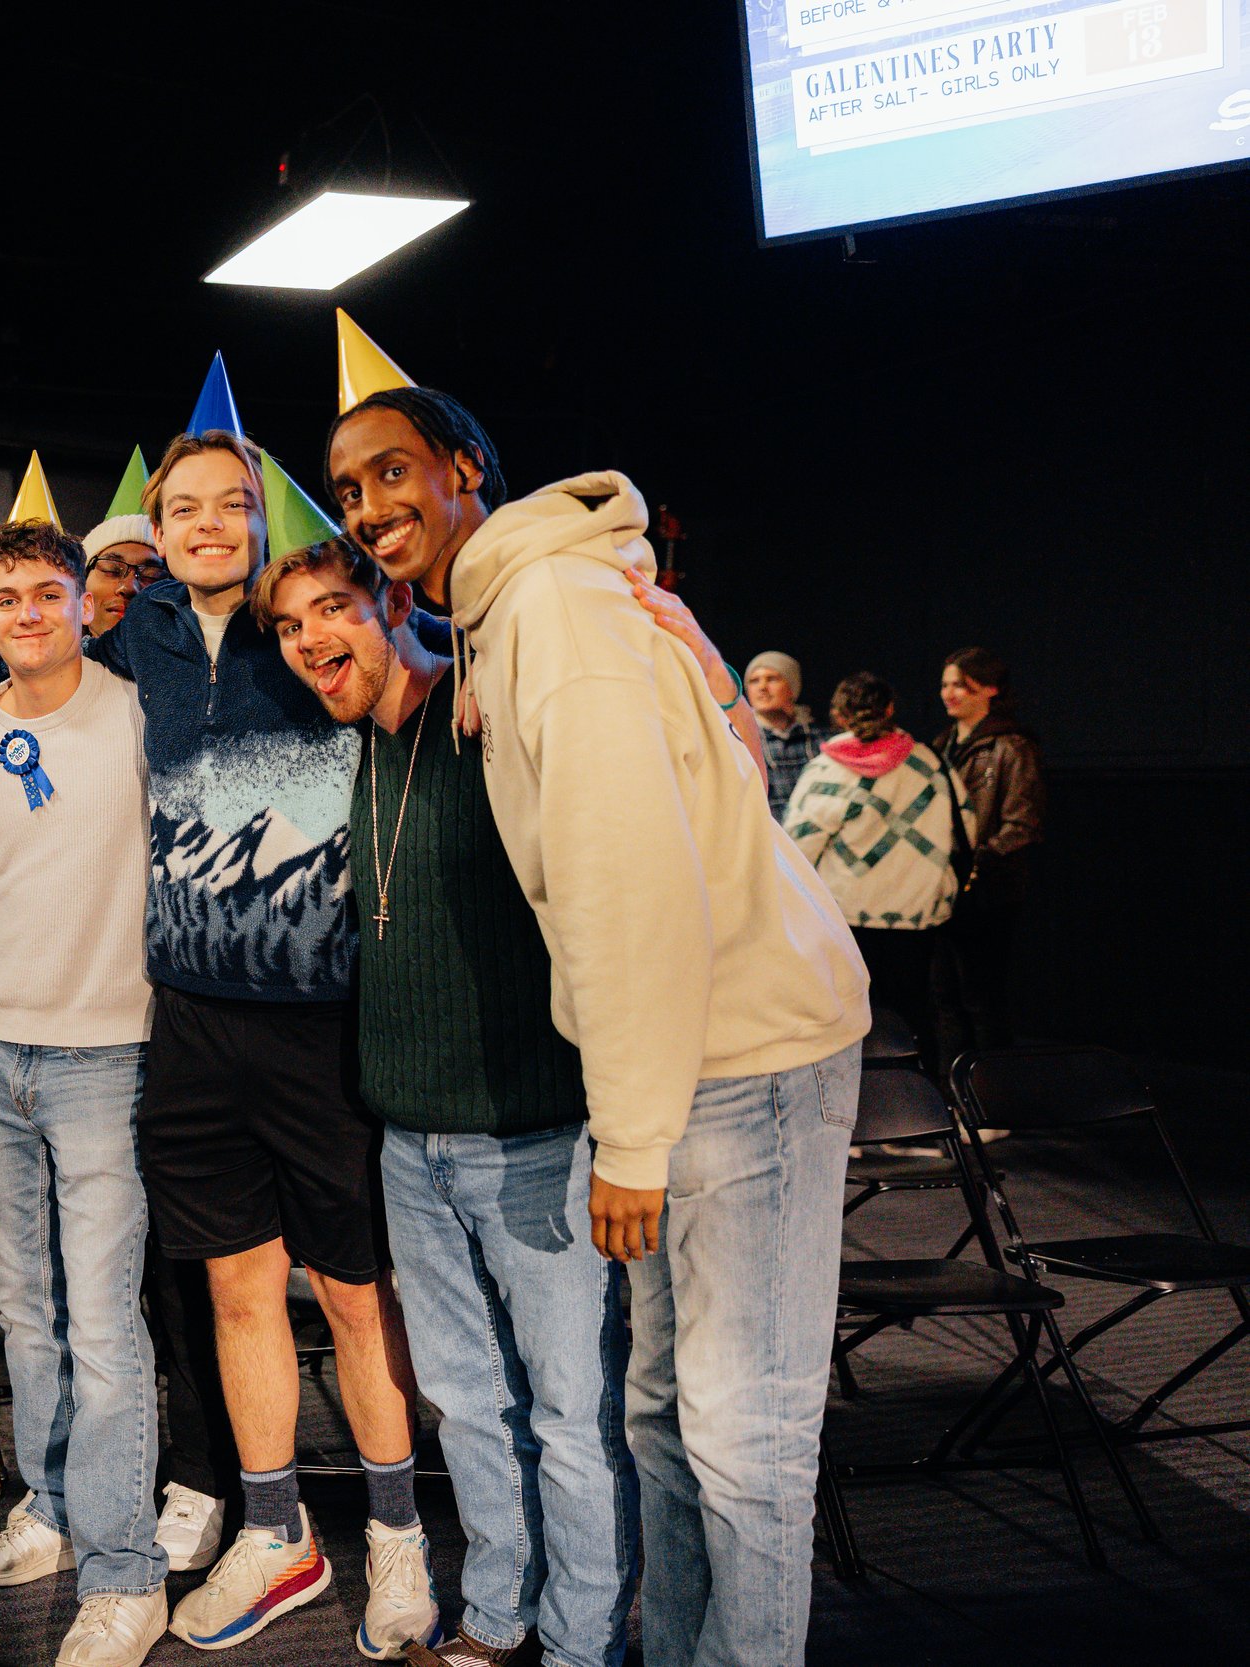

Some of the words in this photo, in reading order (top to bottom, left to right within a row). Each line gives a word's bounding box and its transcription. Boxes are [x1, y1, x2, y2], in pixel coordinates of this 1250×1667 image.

[800, 0, 867, 25] BEFORE
[1122, 4, 1168, 29] FEB
[806, 44, 960, 98] GALENTINES
[973, 23, 1057, 65] PARTY
[1127, 24, 1162, 62] 13
[809, 99, 862, 122] AFTER
[874, 87, 928, 110] SALT-
[941, 71, 999, 96] GIRLS
[1012, 58, 1060, 82] ONLY
